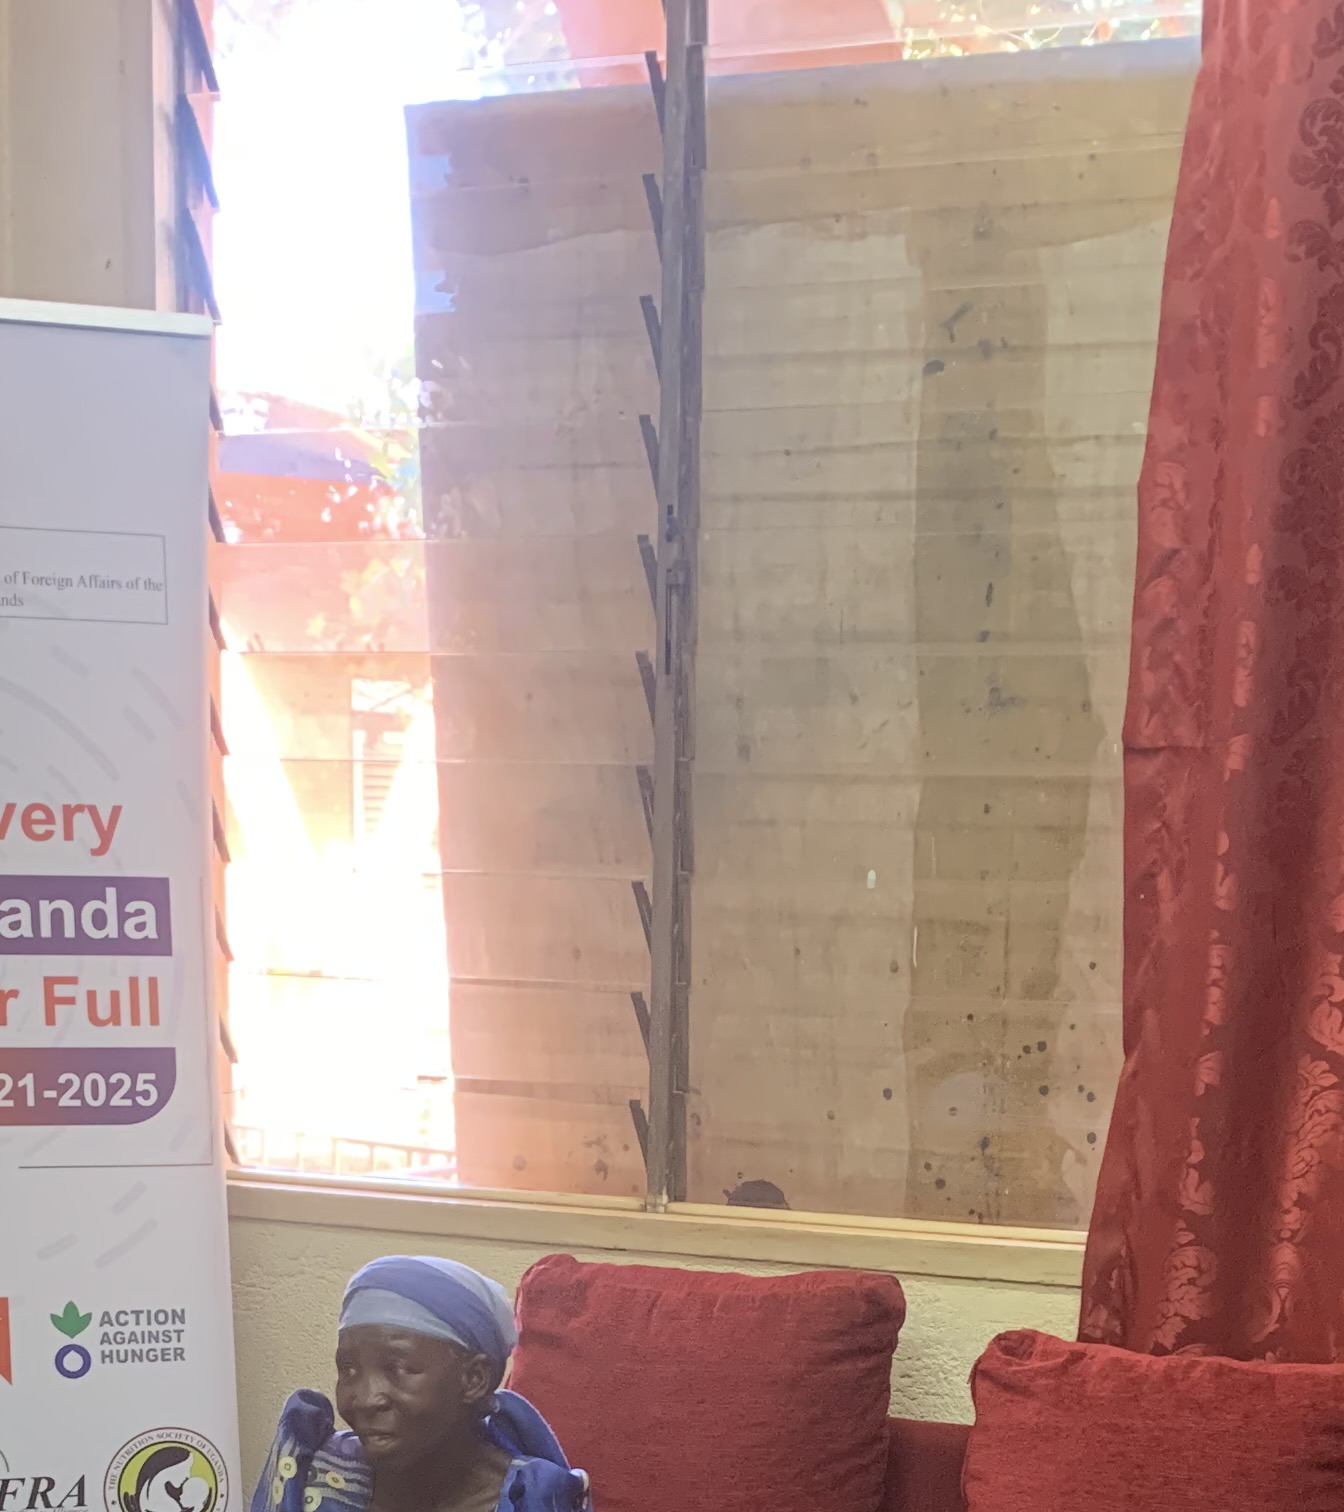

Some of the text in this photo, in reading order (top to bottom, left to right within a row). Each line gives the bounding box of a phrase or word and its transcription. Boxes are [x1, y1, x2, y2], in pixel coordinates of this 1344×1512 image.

[4, 570, 20, 585] of
[22, 571, 73, 590] Foreign
[77, 574, 122, 590] Affairs
[126, 576, 141, 591] of
[143, 577, 163, 592] the
[43, 976, 161, 1027] Full
[99, 1308, 186, 1327] ACTION
[100, 1329, 185, 1346] AGAINST
[100, 1347, 186, 1364] HUNGER
[108, 1432, 224, 1490] THE NUTRITION SOCIETY OF UGANDA
